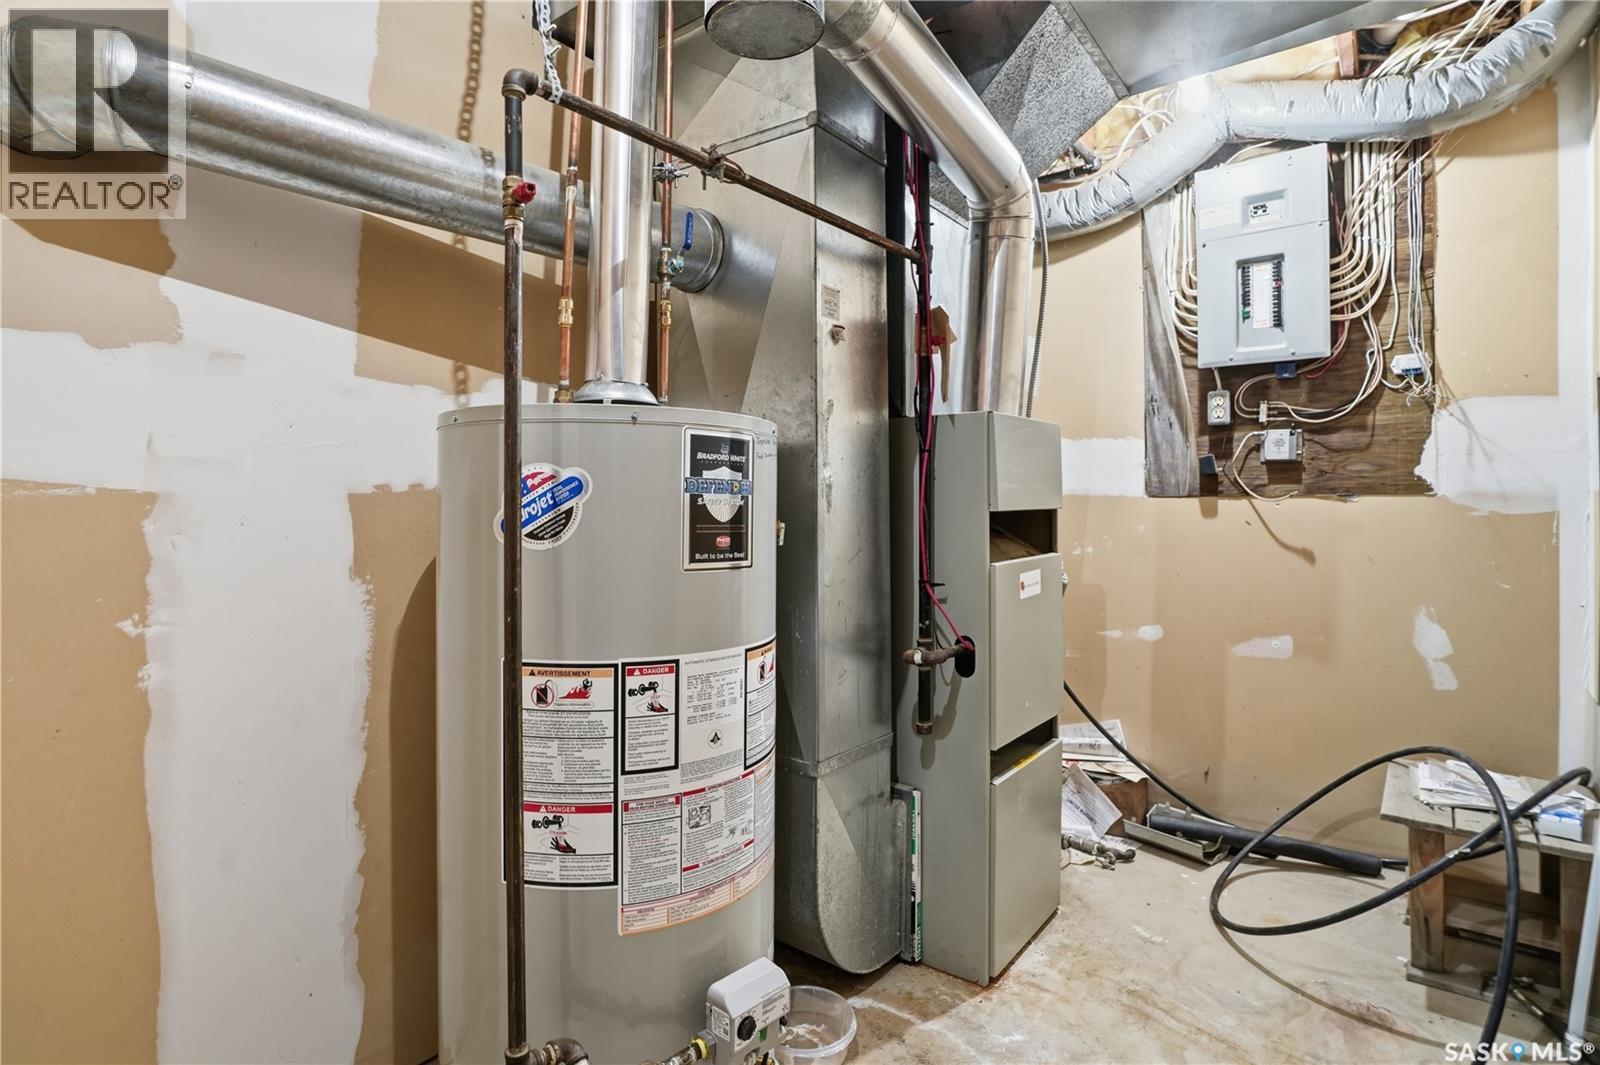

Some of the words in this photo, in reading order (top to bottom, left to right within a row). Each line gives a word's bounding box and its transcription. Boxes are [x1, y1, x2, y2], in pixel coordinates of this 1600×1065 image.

[696, 452, 730, 461] BRADFORD
[730, 454, 747, 463] WHITE
[685, 477, 753, 495] DEFENDER
[536, 669, 592, 677] AVERTISSEMENT
[642, 666, 670, 674] DANGER
[547, 805, 576, 813] DANGER
